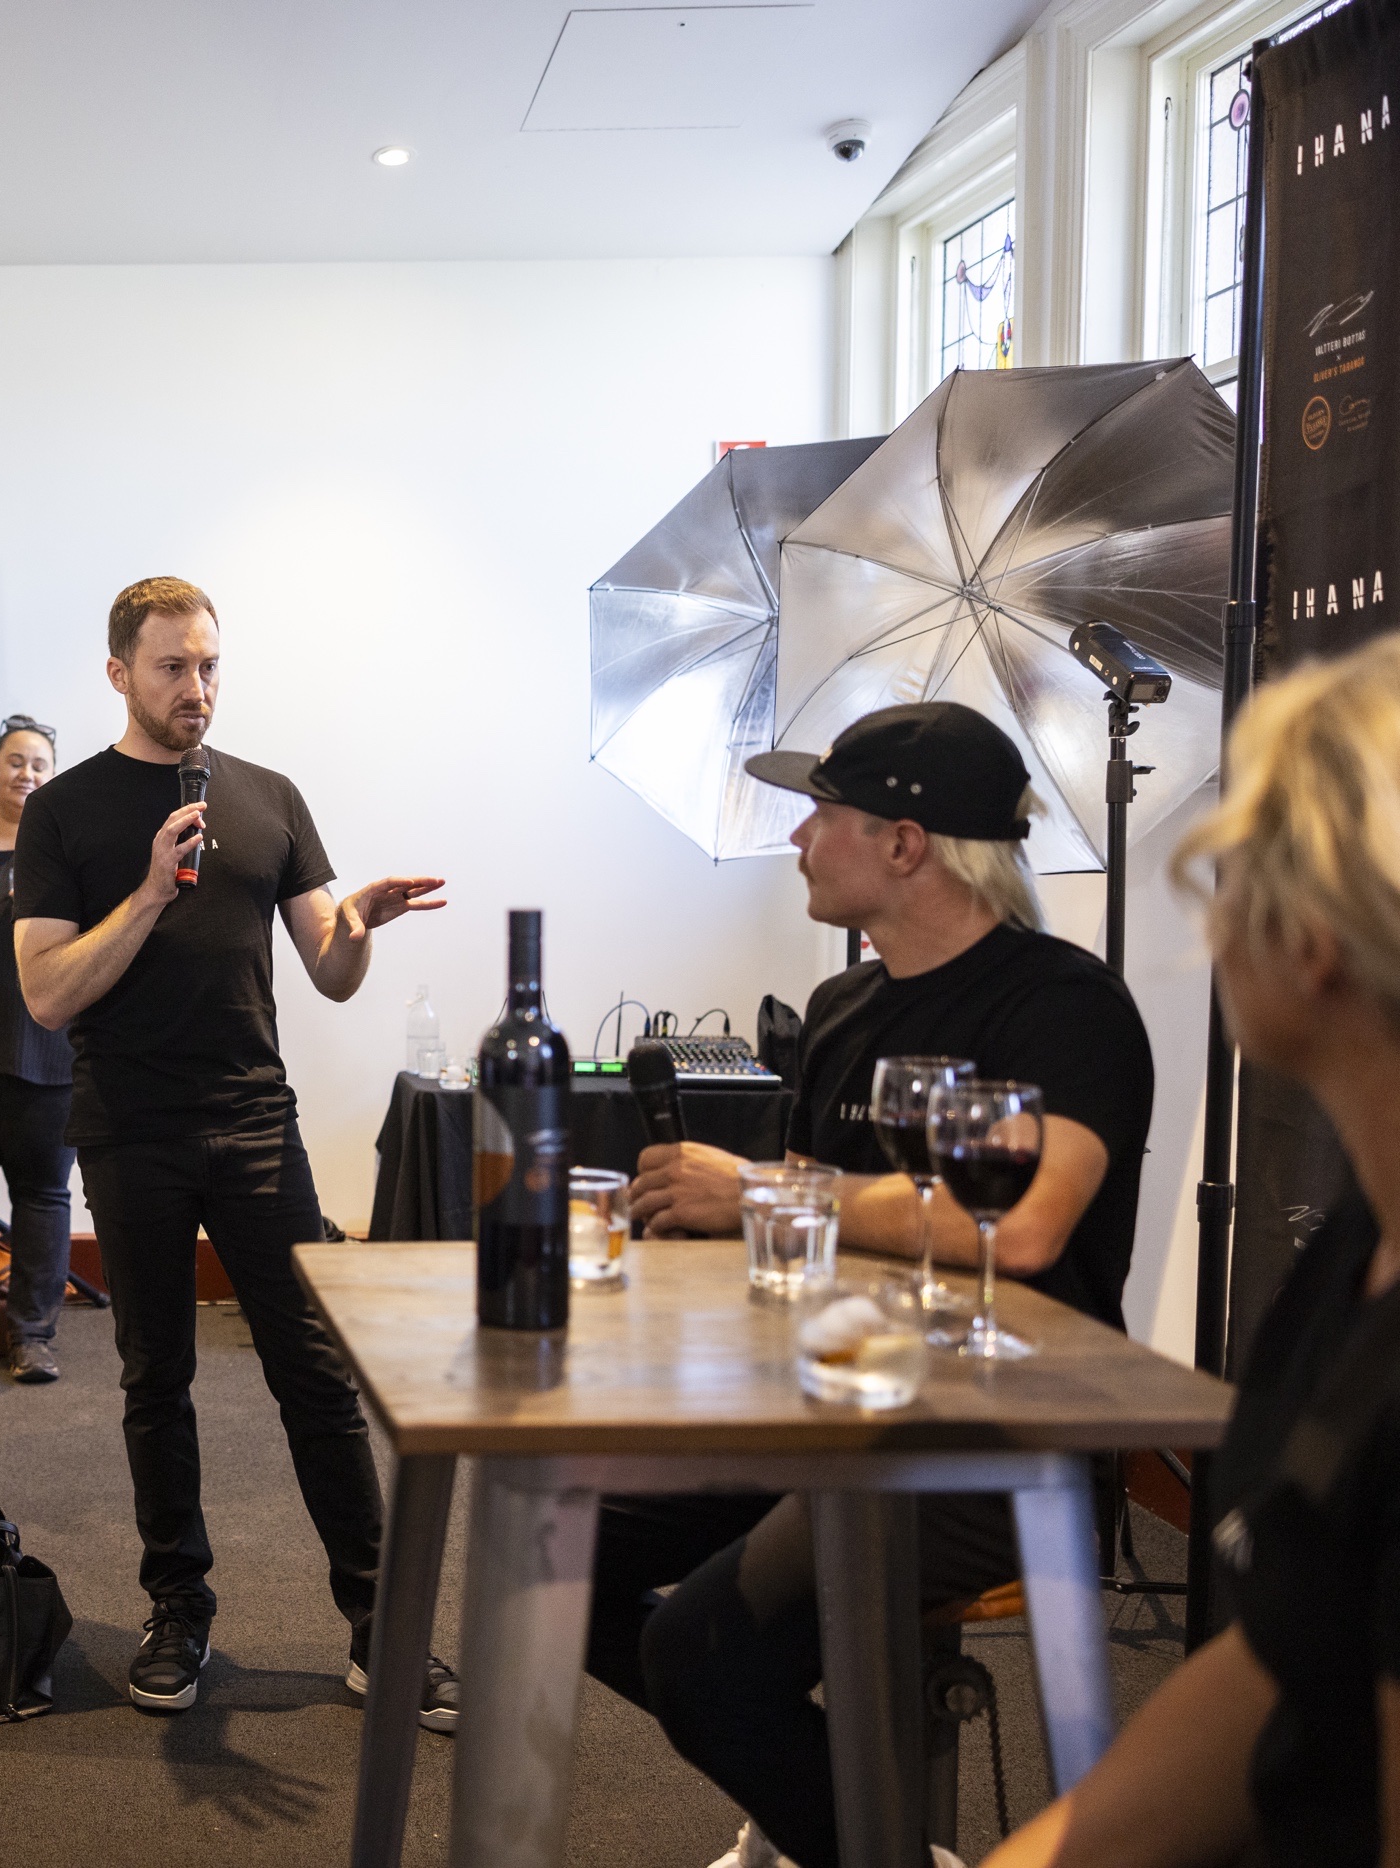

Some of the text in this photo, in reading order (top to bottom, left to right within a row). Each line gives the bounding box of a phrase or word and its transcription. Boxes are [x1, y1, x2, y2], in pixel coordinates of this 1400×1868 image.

[1297, 94, 1391, 175] IHANA
[1342, 330, 1366, 347] BOTTAS
[1293, 570, 1384, 620] IHANA
